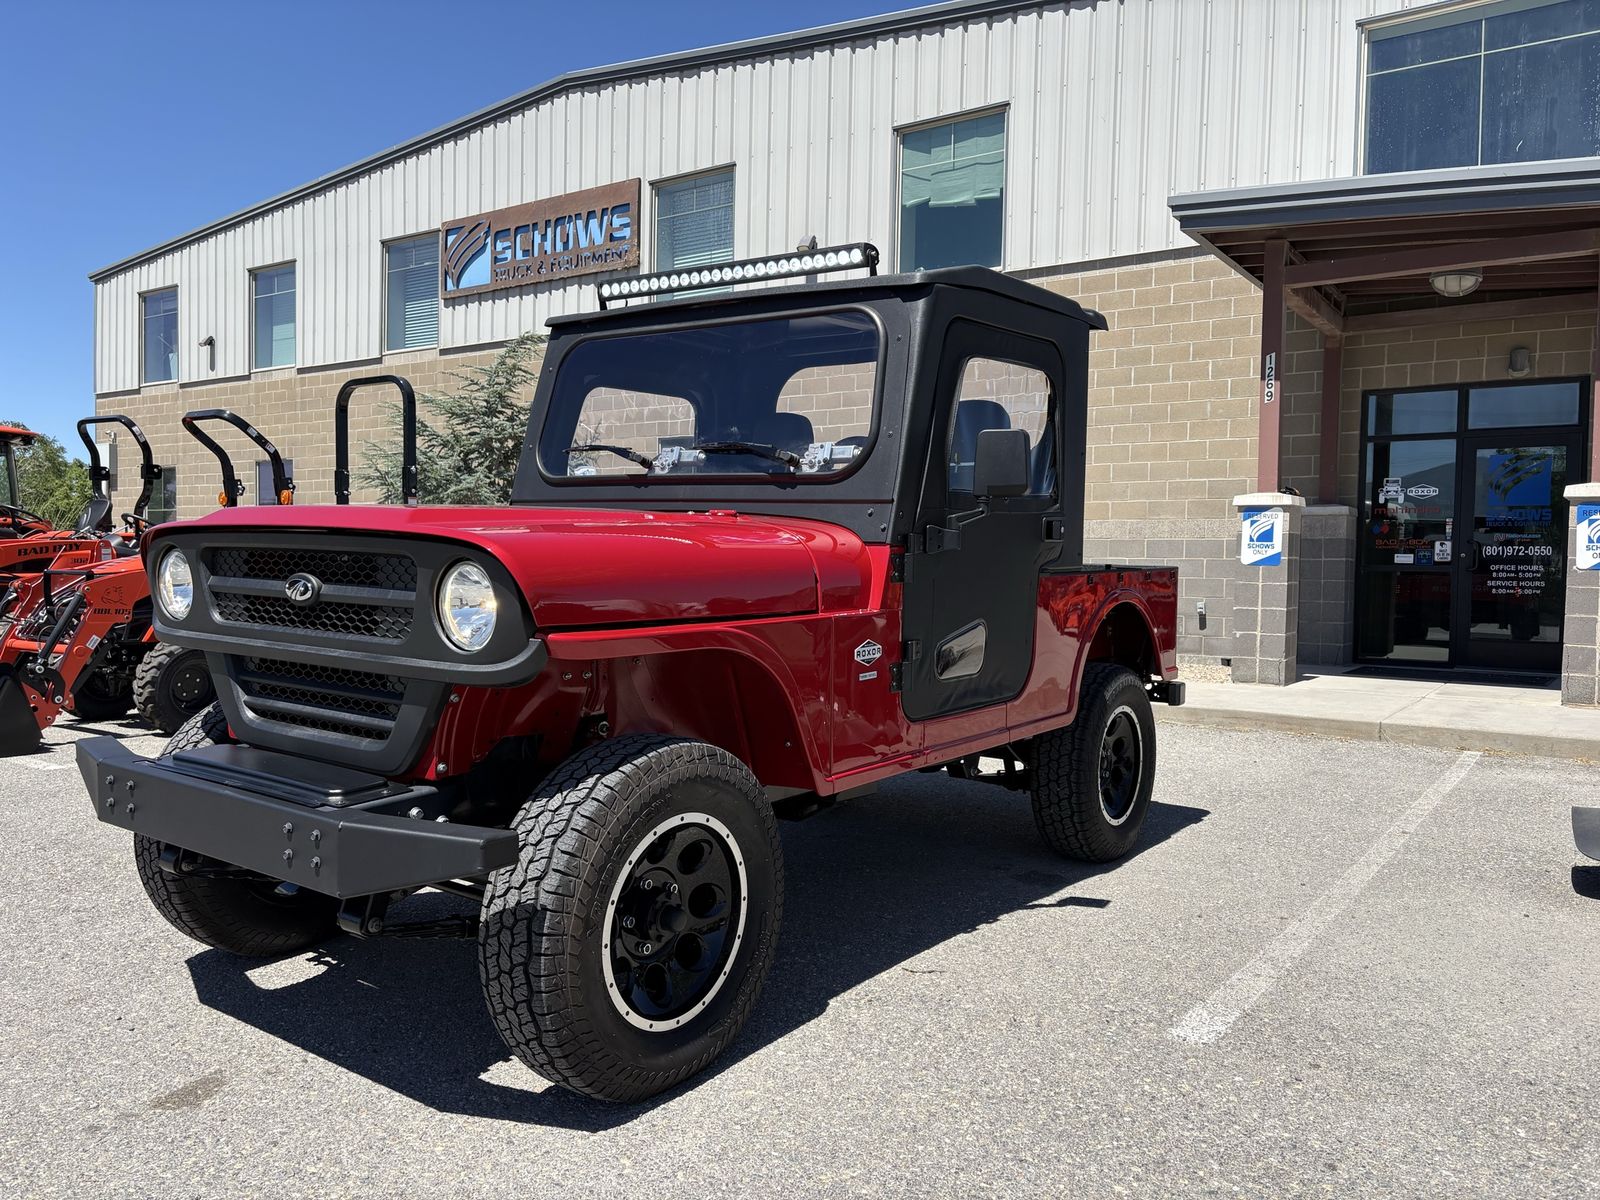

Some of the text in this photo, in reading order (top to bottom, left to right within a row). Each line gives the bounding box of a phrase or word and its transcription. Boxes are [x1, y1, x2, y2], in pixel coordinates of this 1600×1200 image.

[493, 202, 631, 265] SCHOWS
[494, 245, 631, 282] TRUCK & EQUIPMENT
[1266, 354, 1274, 402] 1269
[1247, 512, 1279, 520] RESERVED
[17, 543, 82, 557] BAD BOY
[1482, 546, 1552, 558] (801)972-0550
[856, 646, 881, 659] ROXOR
